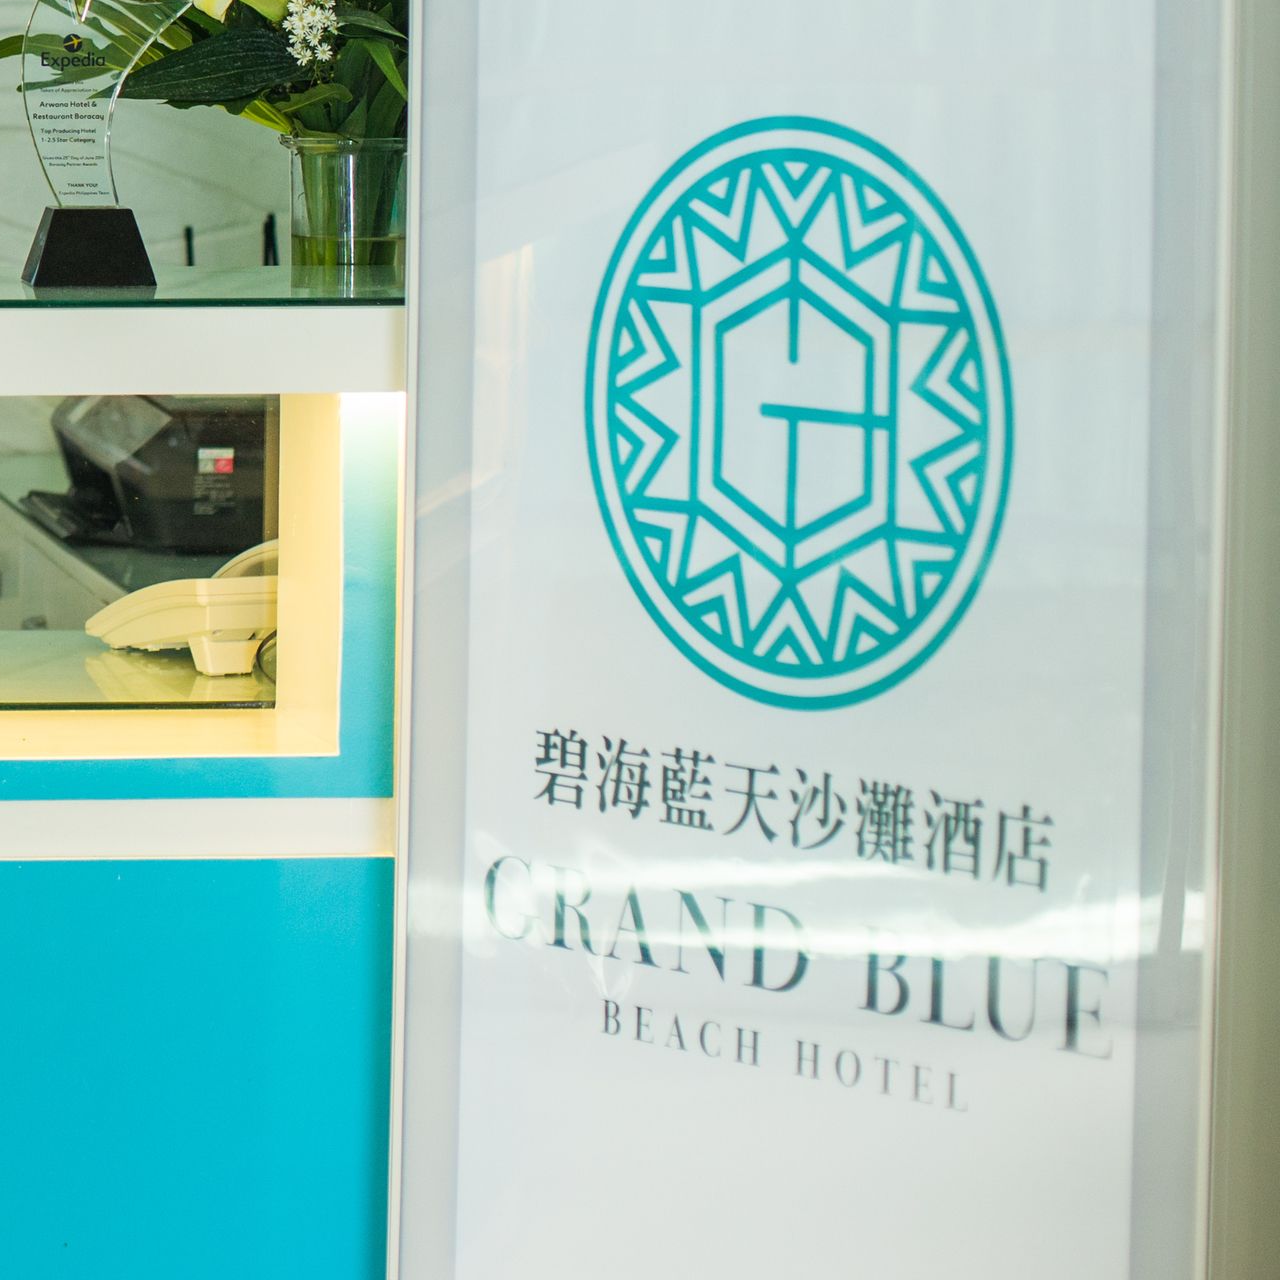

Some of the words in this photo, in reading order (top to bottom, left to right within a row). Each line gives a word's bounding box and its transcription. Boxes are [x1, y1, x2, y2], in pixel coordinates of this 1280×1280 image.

[41, 51, 106, 72] Expedia
[74, 113, 105, 121] Boracay
[533, 728, 1055, 893] 碧海藍天沙灘酒店
[483, 854, 811, 993] GRAND
[858, 924, 1113, 1061] BLUE
[600, 998, 762, 1068] BEACH
[794, 1039, 969, 1113] HOTEL
